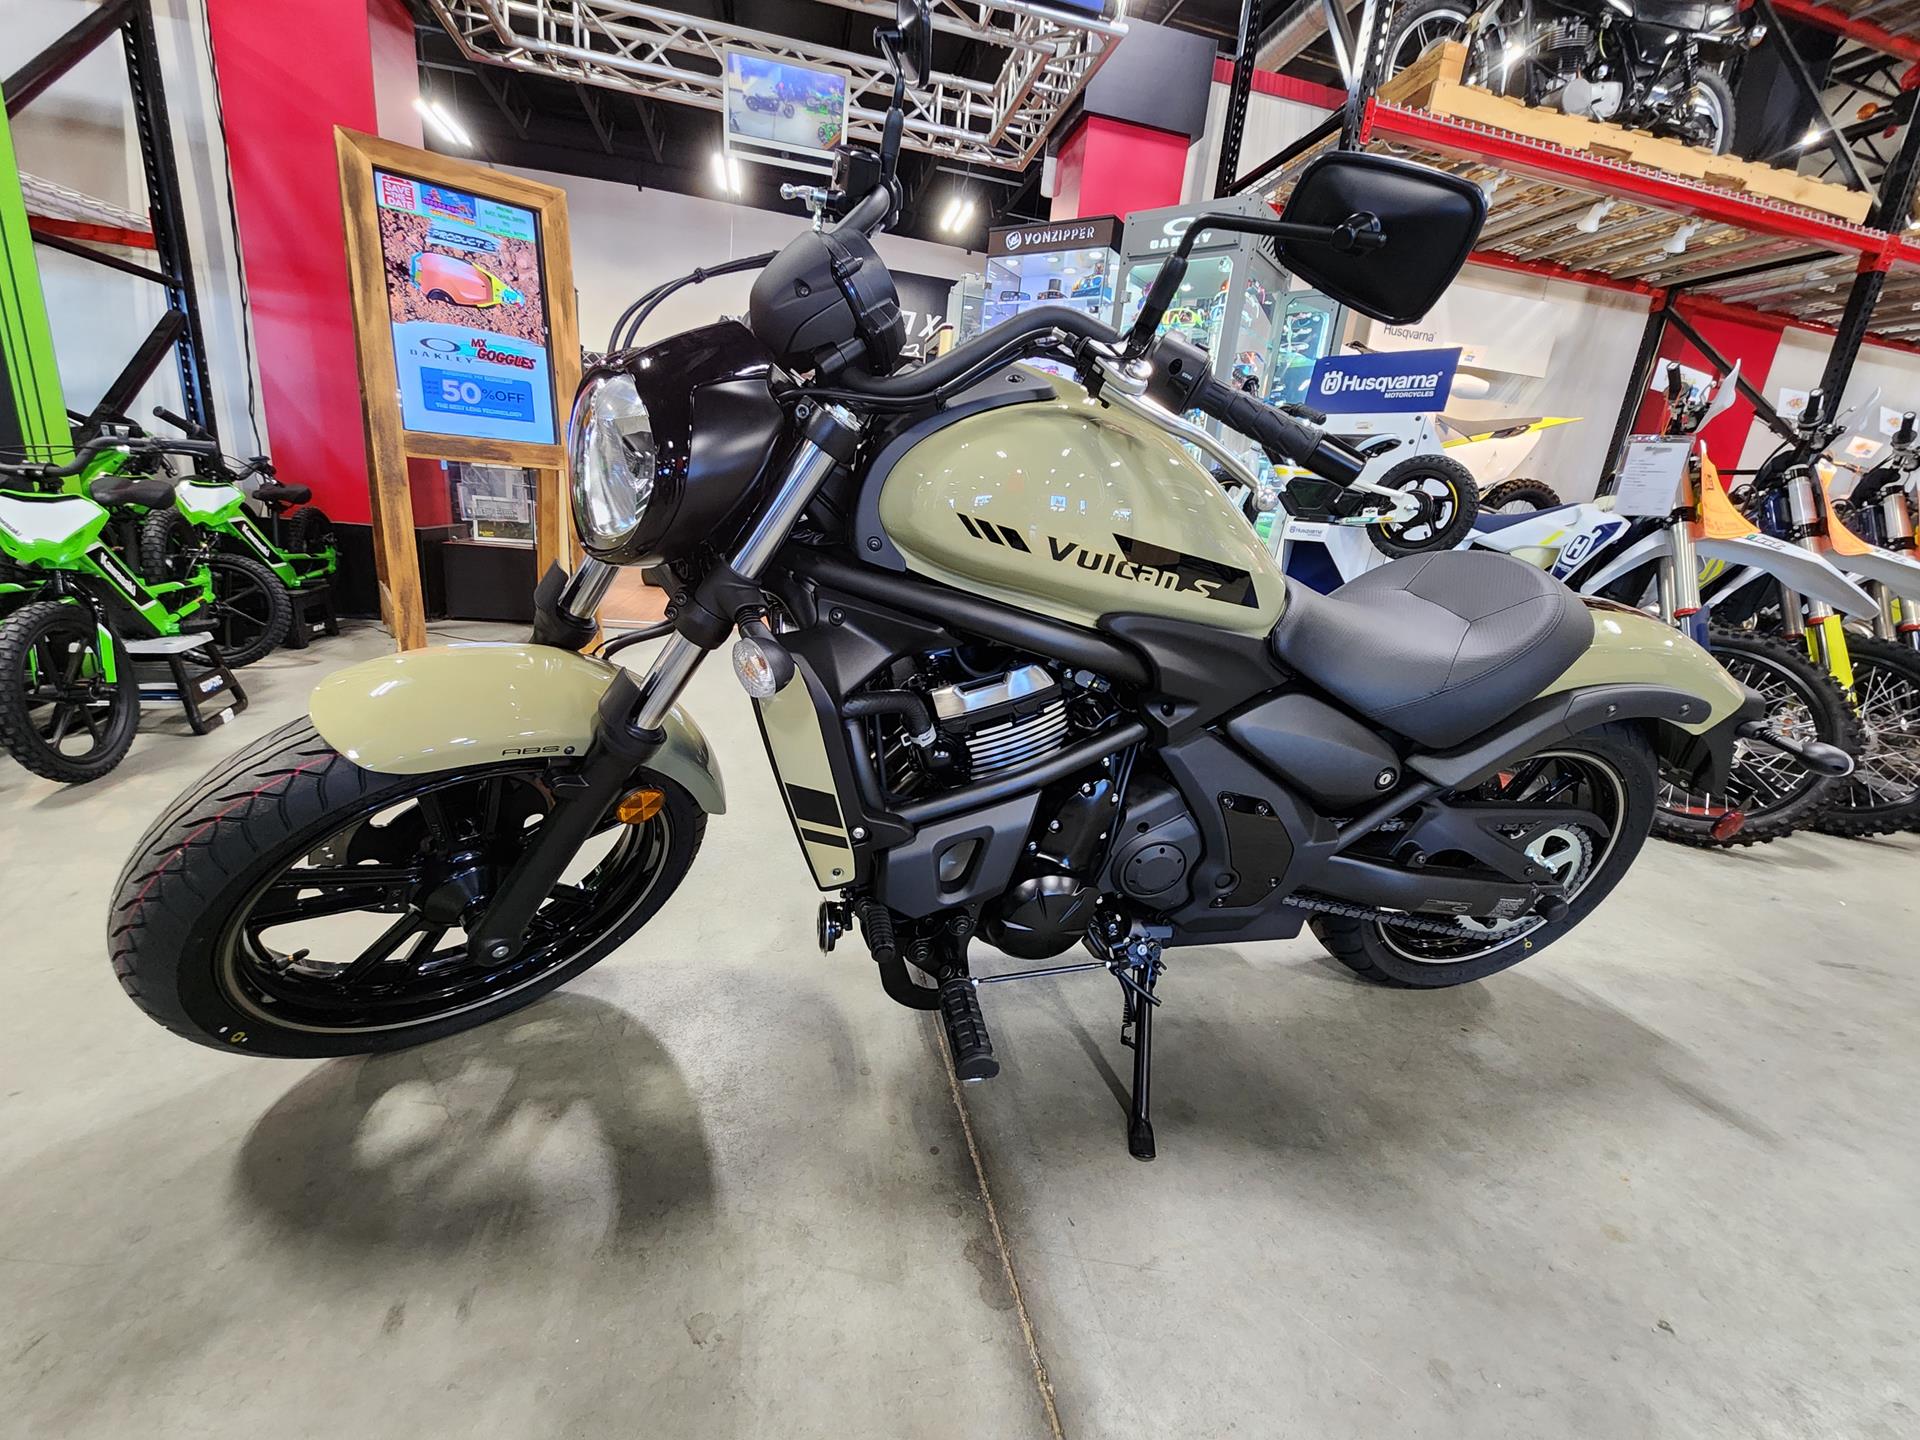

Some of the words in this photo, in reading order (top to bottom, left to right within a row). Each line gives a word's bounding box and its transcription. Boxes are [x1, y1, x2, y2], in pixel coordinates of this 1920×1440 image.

[385, 182, 412, 197] SAVE
[386, 196, 414, 210] DATE
[1024, 226, 1095, 245] VONZIPPER
[1384, 324, 1435, 342] Husqvarna
[471, 338, 487, 348] MX
[409, 349, 473, 364] OAKLEY
[477, 348, 537, 370] GOGGLES
[1342, 373, 1438, 393] Husqvarna
[1384, 390, 1434, 399] MOTORCYCLES
[1047, 536, 1181, 593] Vulcan
[1184, 579, 1223, 598] S
[502, 745, 560, 756] ABS
